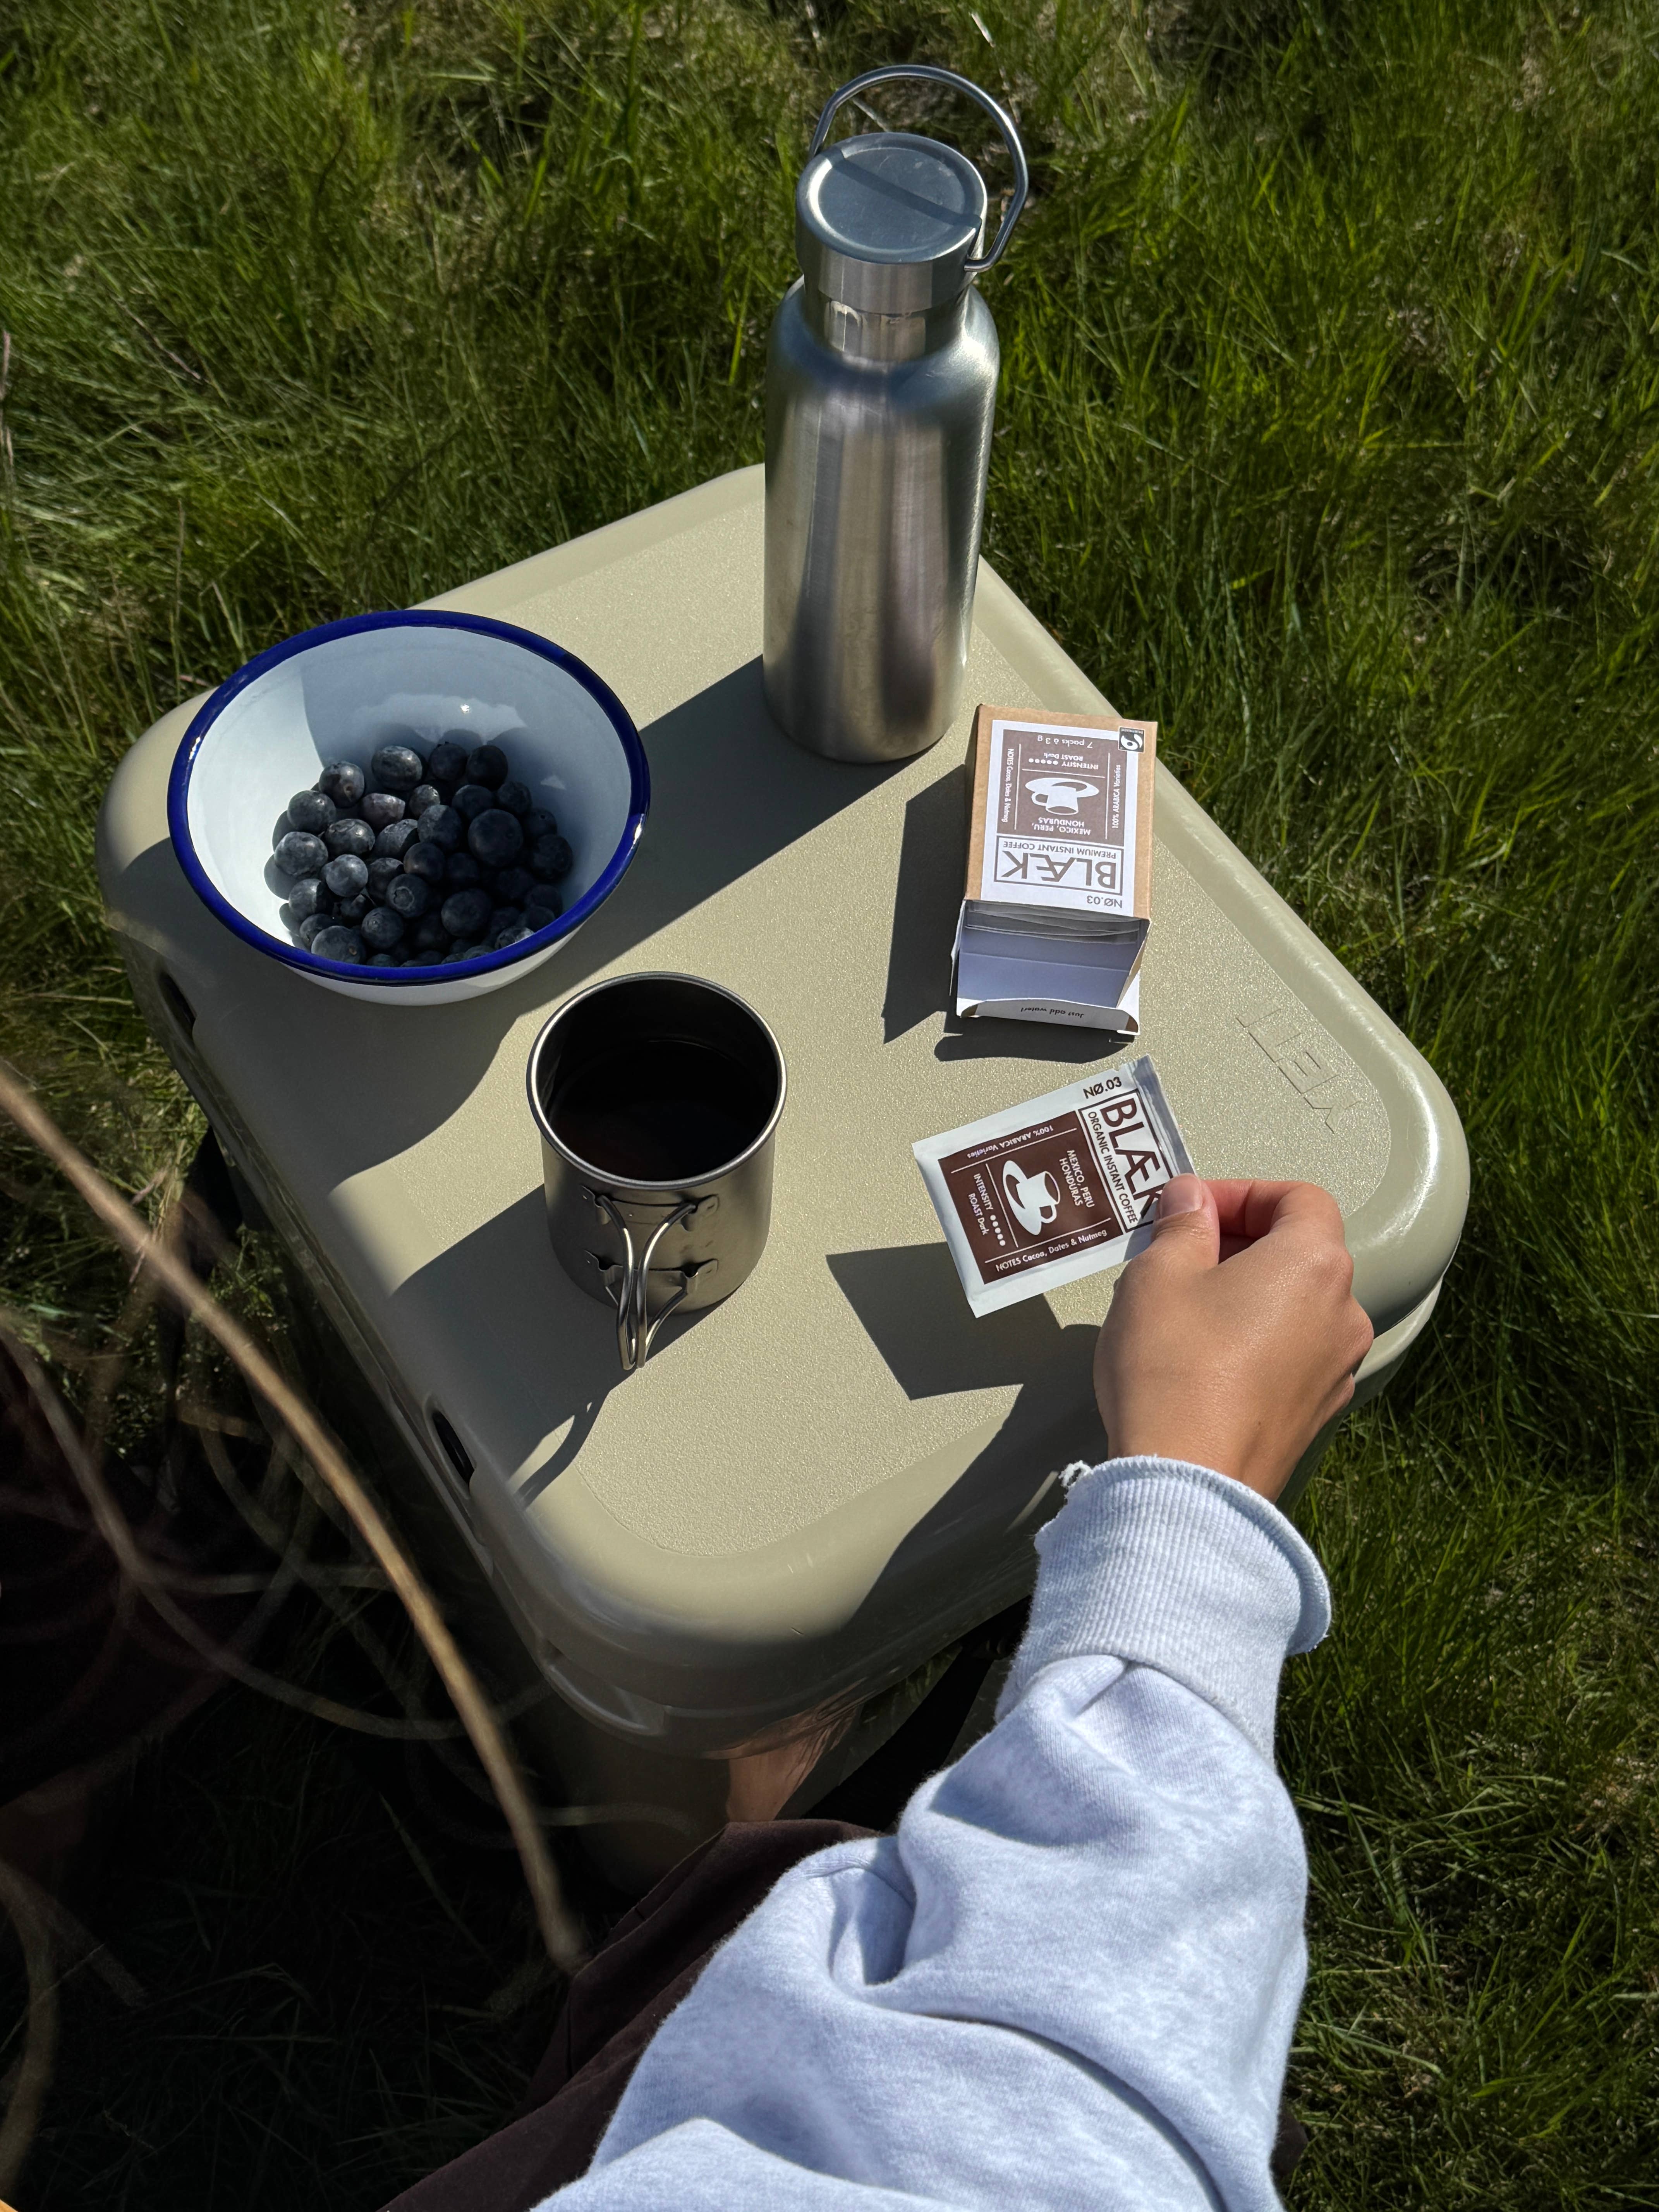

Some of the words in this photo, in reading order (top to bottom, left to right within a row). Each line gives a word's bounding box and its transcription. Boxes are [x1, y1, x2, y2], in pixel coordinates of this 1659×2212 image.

[1061, 739, 1085, 747] packs
[1061, 753, 1084, 761] ROAST
[1061, 761, 1099, 770] INTENSITY
[1001, 803, 1011, 823] Nutmeg
[1031, 823, 1054, 832] PERU,
[1038, 817, 1085, 828] HONDURAS
[1056, 825, 1091, 836] MEXICO,
[1003, 841, 1035, 850] COFFEE
[1037, 844, 1074, 854] INSTANT
[1077, 848, 1116, 859] PREMIUM
[1001, 850, 1116, 890] BLÆK
[1086, 895, 1123, 908] NØ.03
[1083, 1077, 1122, 1099] NØ.03
[1032, 1125, 1054, 1137] 100%
[999, 1132, 1031, 1148] ARABICA
[967, 1144, 999, 1159] Varieties
[1088, 1111, 1108, 1154] ORGANIC
[1104, 1156, 1125, 1191] INSTANT
[1119, 1193, 1138, 1223] COFFEE
[1059, 1158, 1083, 1206] HONDURAS
[1066, 1149, 1085, 1186] MEXICO,
[1080, 1187, 1095, 1208] PERU
[973, 1173, 994, 1211] INTENSITY
[968, 1193, 982, 1216] ROAST
[977, 1218, 990, 1235] Dark
[995, 1256, 1021, 1272] NOTES
[1022, 1251, 1048, 1262] Cocoa,
[1048, 1242, 1069, 1254] Dates
[1077, 1230, 1108, 1243] Nutmeg
